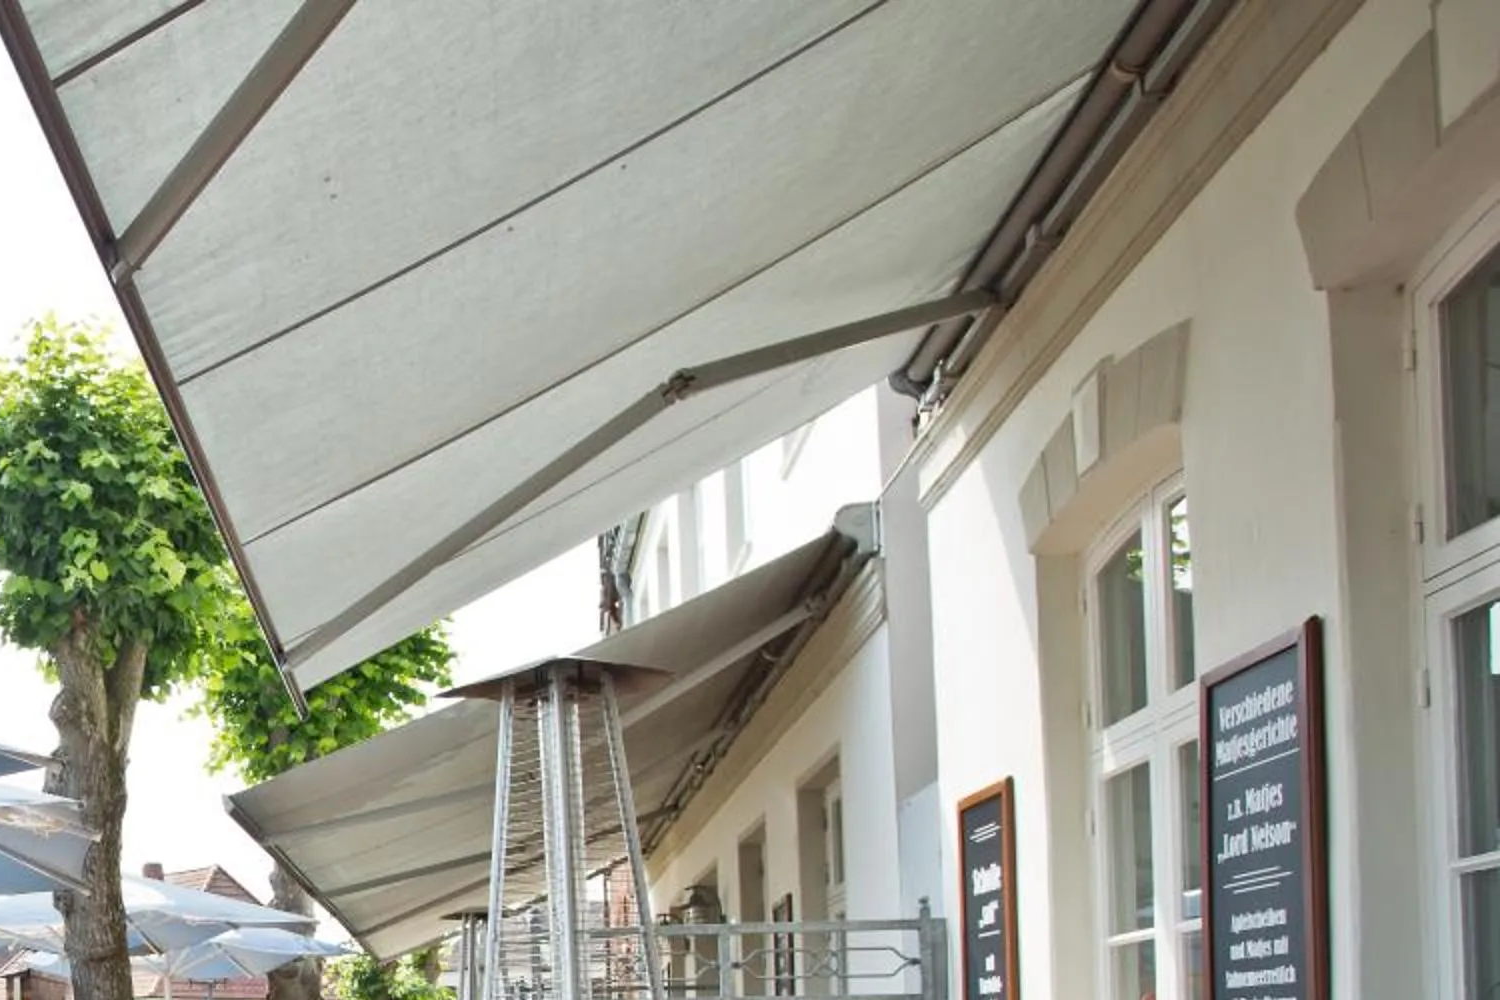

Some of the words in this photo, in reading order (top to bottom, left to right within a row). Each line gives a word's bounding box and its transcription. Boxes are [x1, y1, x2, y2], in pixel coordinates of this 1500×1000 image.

[1219, 680, 1293, 732] Verschiedene
[1215, 714, 1297, 767] Matjesgerichte
[1245, 783, 1283, 815] Matjes
